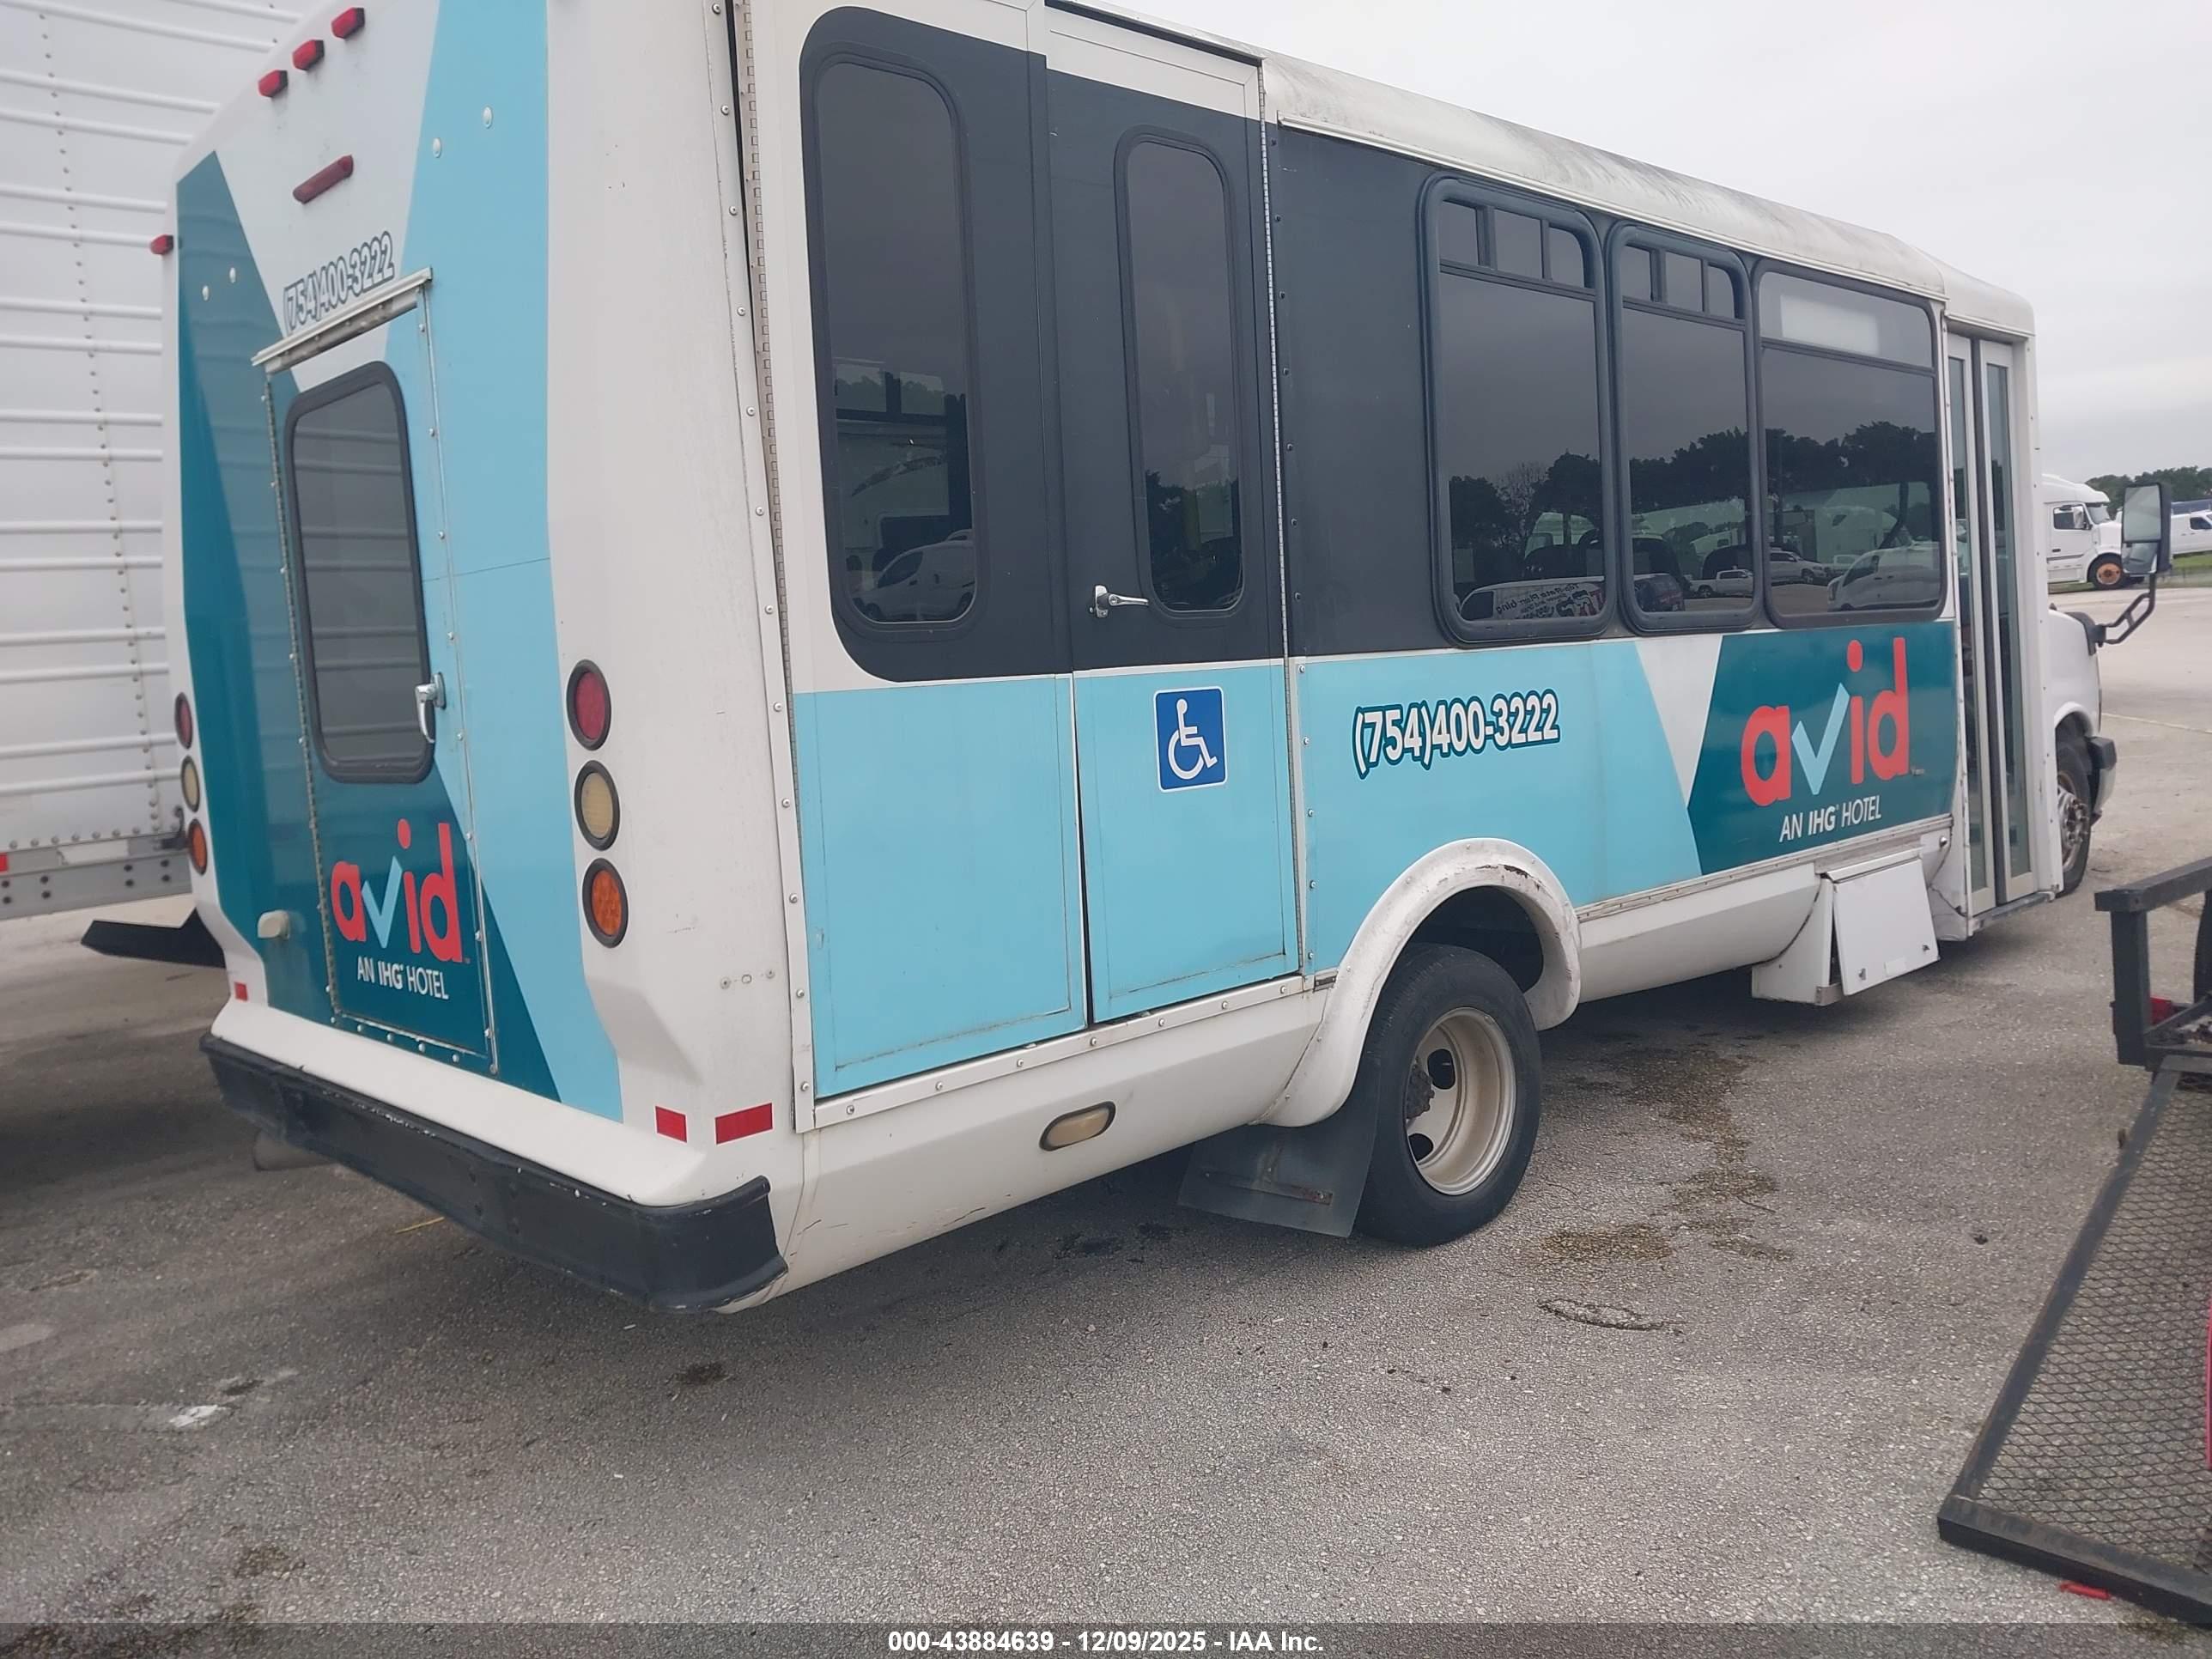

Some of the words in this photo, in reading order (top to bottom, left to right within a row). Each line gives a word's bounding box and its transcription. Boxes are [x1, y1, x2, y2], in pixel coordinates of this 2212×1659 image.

[283, 230, 395, 335] (754)400-3222
[1352, 688, 1561, 780] (754)400-3222
[1741, 636, 1910, 807] avid
[1778, 811, 1803, 843] AN
[1841, 794, 1882, 829] HOTEL
[330, 818, 463, 963] avid
[356, 955, 375, 984] AN
[406, 965, 450, 1000] HOTEL
